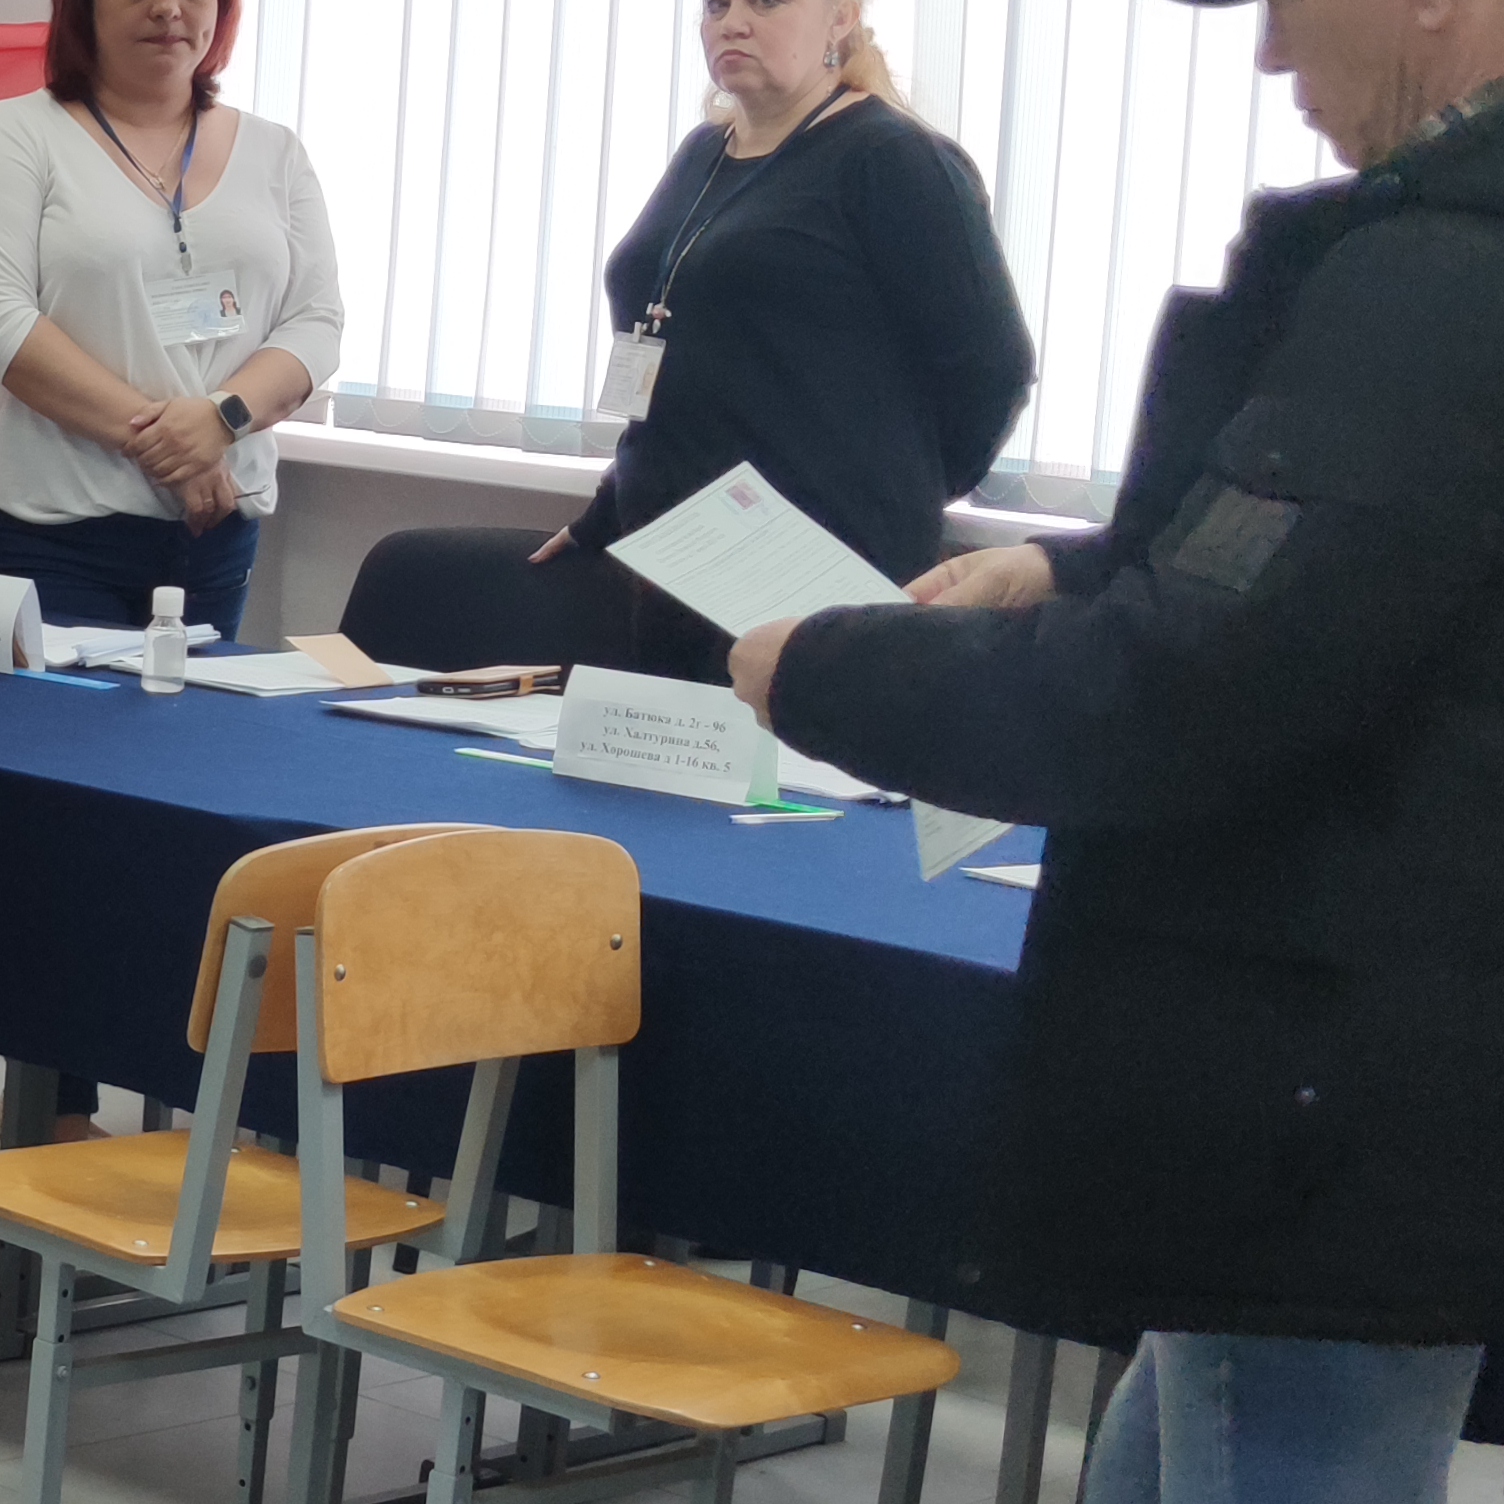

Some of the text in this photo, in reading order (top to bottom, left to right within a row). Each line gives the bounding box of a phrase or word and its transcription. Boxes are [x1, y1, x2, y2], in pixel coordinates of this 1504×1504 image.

[603, 707, 621, 717] ул.
[625, 708, 671, 725] Батюка
[713, 721, 726, 733] 96
[603, 726, 620, 736] ул.
[624, 727, 690, 747] Халтурина
[580, 741, 597, 752] ул.
[601, 742, 660, 762] Хорошева
[702, 761, 720, 771] кв.
[723, 762, 731, 773] 5
